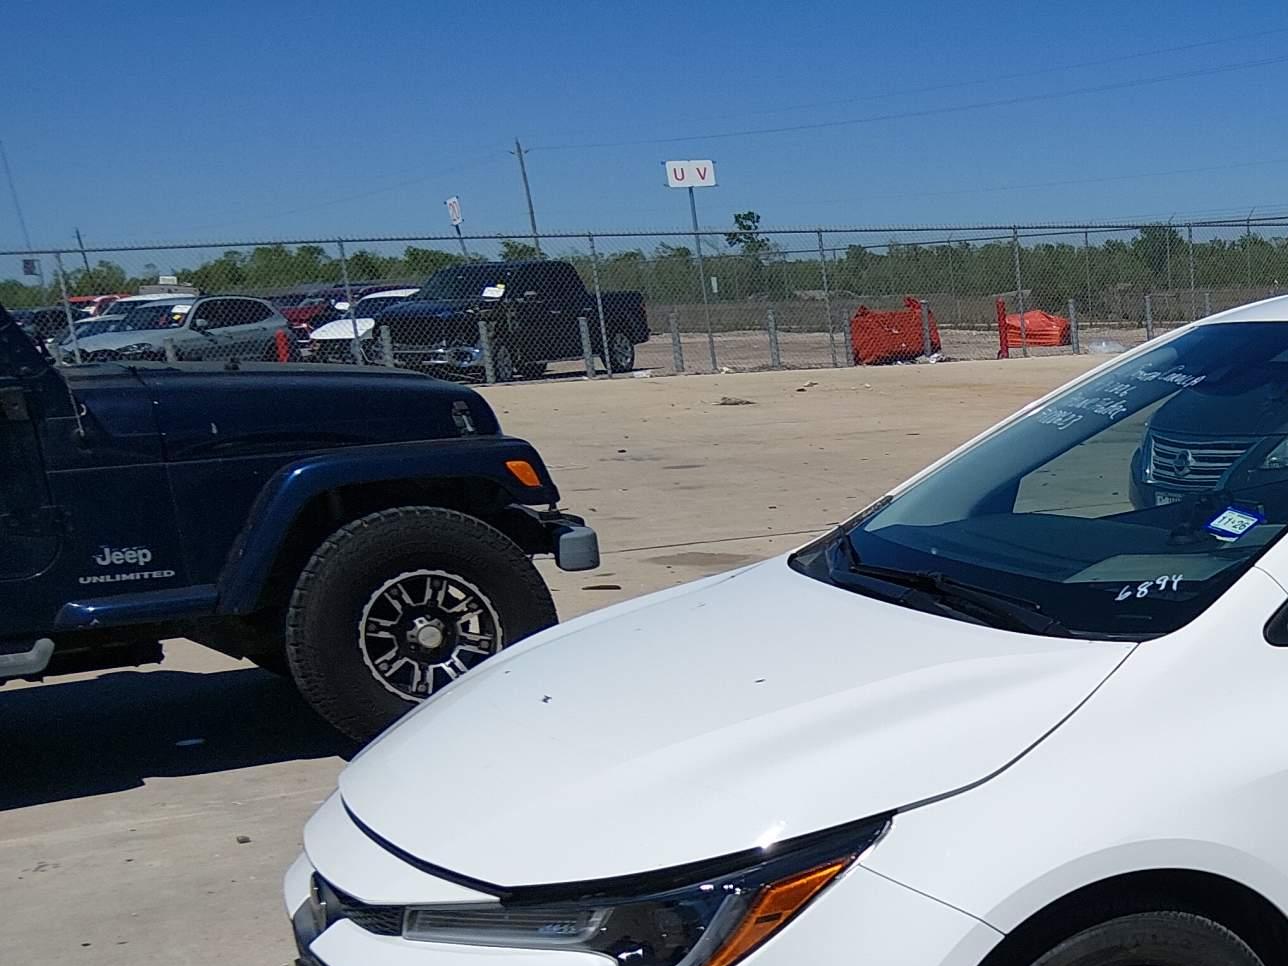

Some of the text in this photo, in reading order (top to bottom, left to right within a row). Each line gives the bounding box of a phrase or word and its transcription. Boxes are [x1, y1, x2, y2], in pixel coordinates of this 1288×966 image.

[673, 167, 708, 182] U V
[95, 547, 152, 566] Jeep
[78, 569, 176, 584] UNLIMITED
[1114, 573, 1184, 601] 6894
